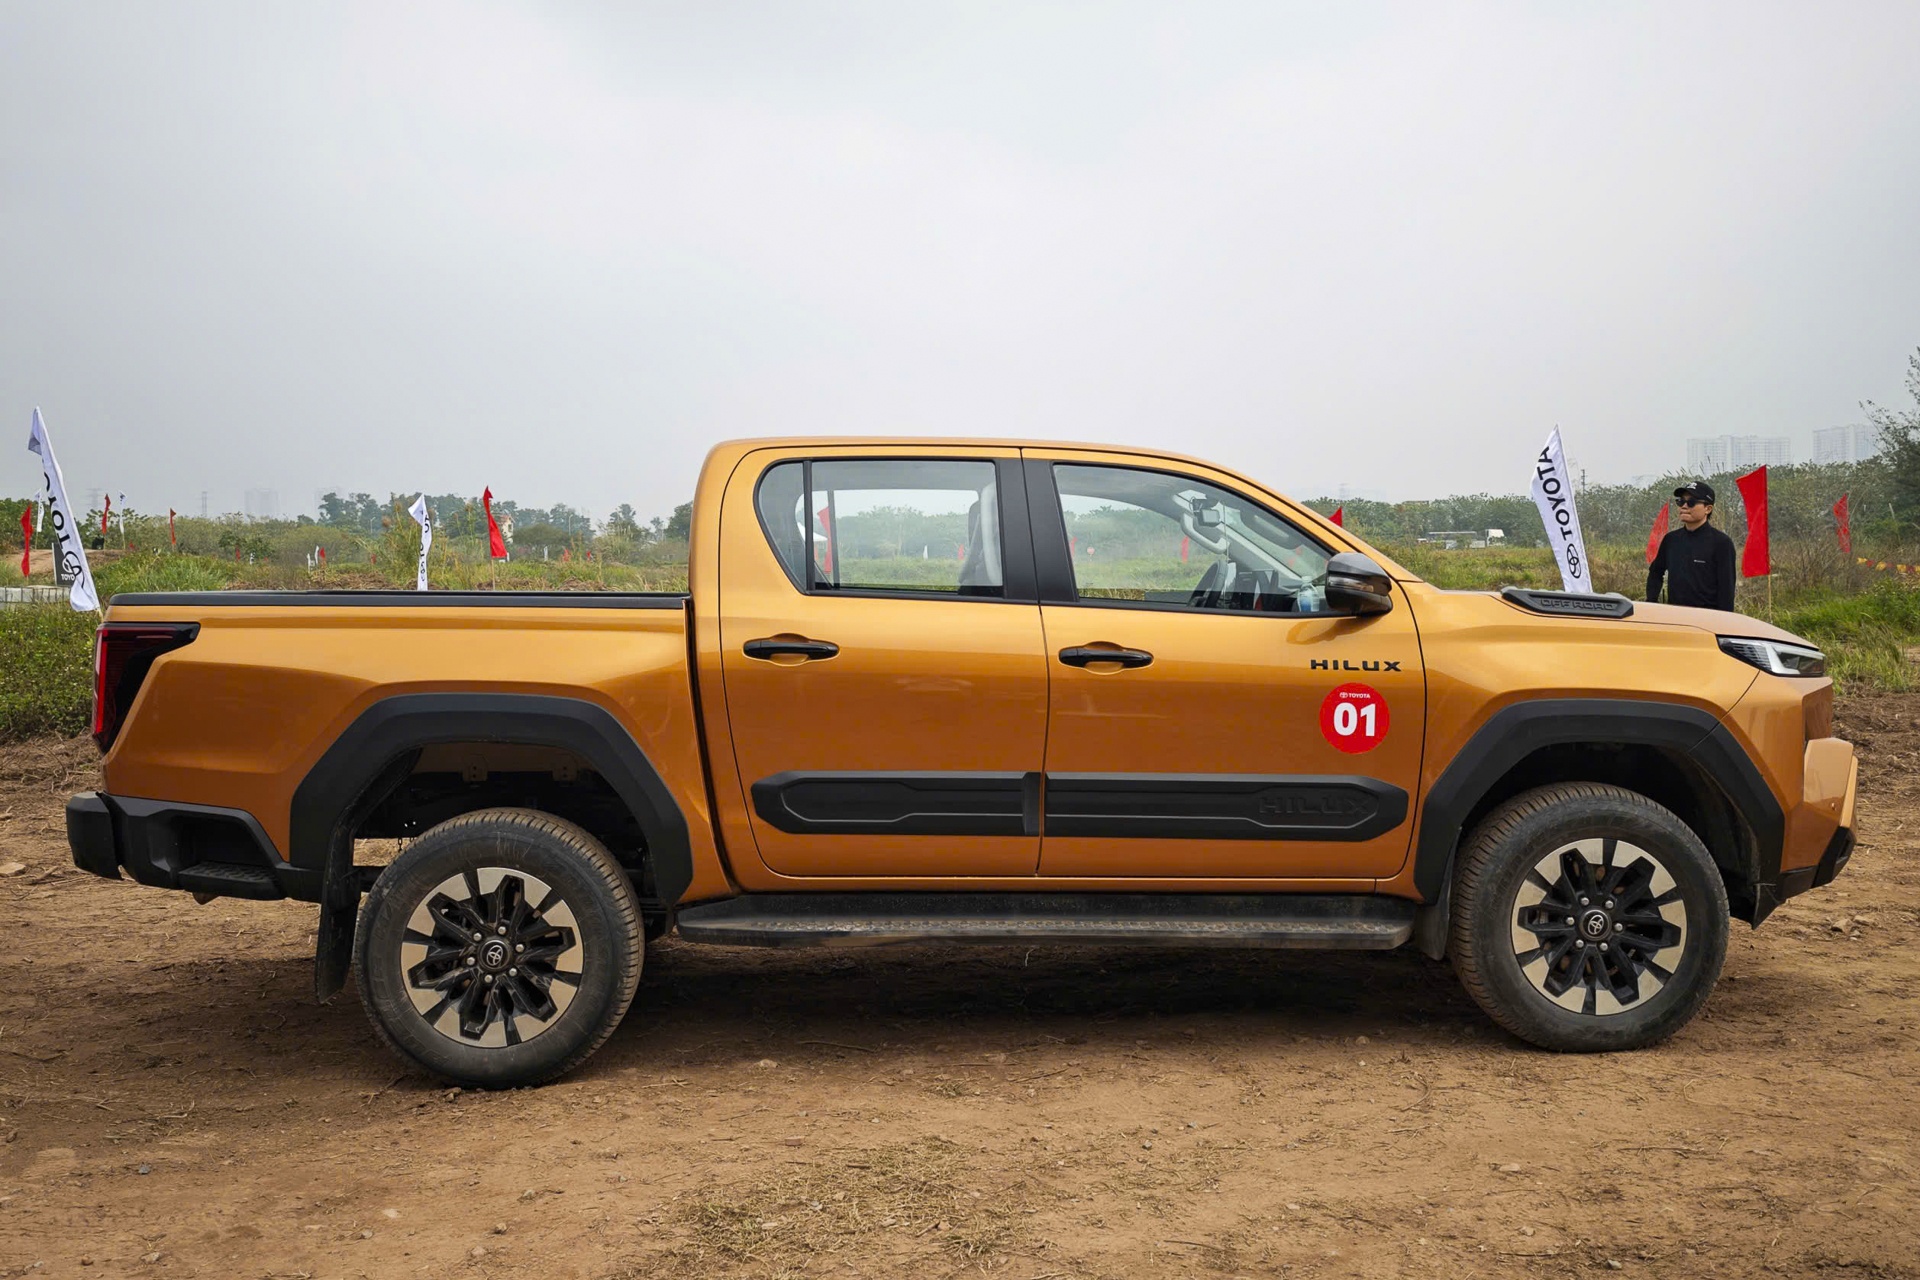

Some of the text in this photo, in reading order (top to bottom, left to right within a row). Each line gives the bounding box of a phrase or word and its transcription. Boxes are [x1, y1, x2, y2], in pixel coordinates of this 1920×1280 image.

[1537, 446, 1573, 541] TOYOTA
[1541, 599, 1614, 611] OFF ROAD
[1310, 659, 1402, 672] HILUX
[1333, 702, 1376, 737] 01
[1258, 797, 1370, 814] HILUX
